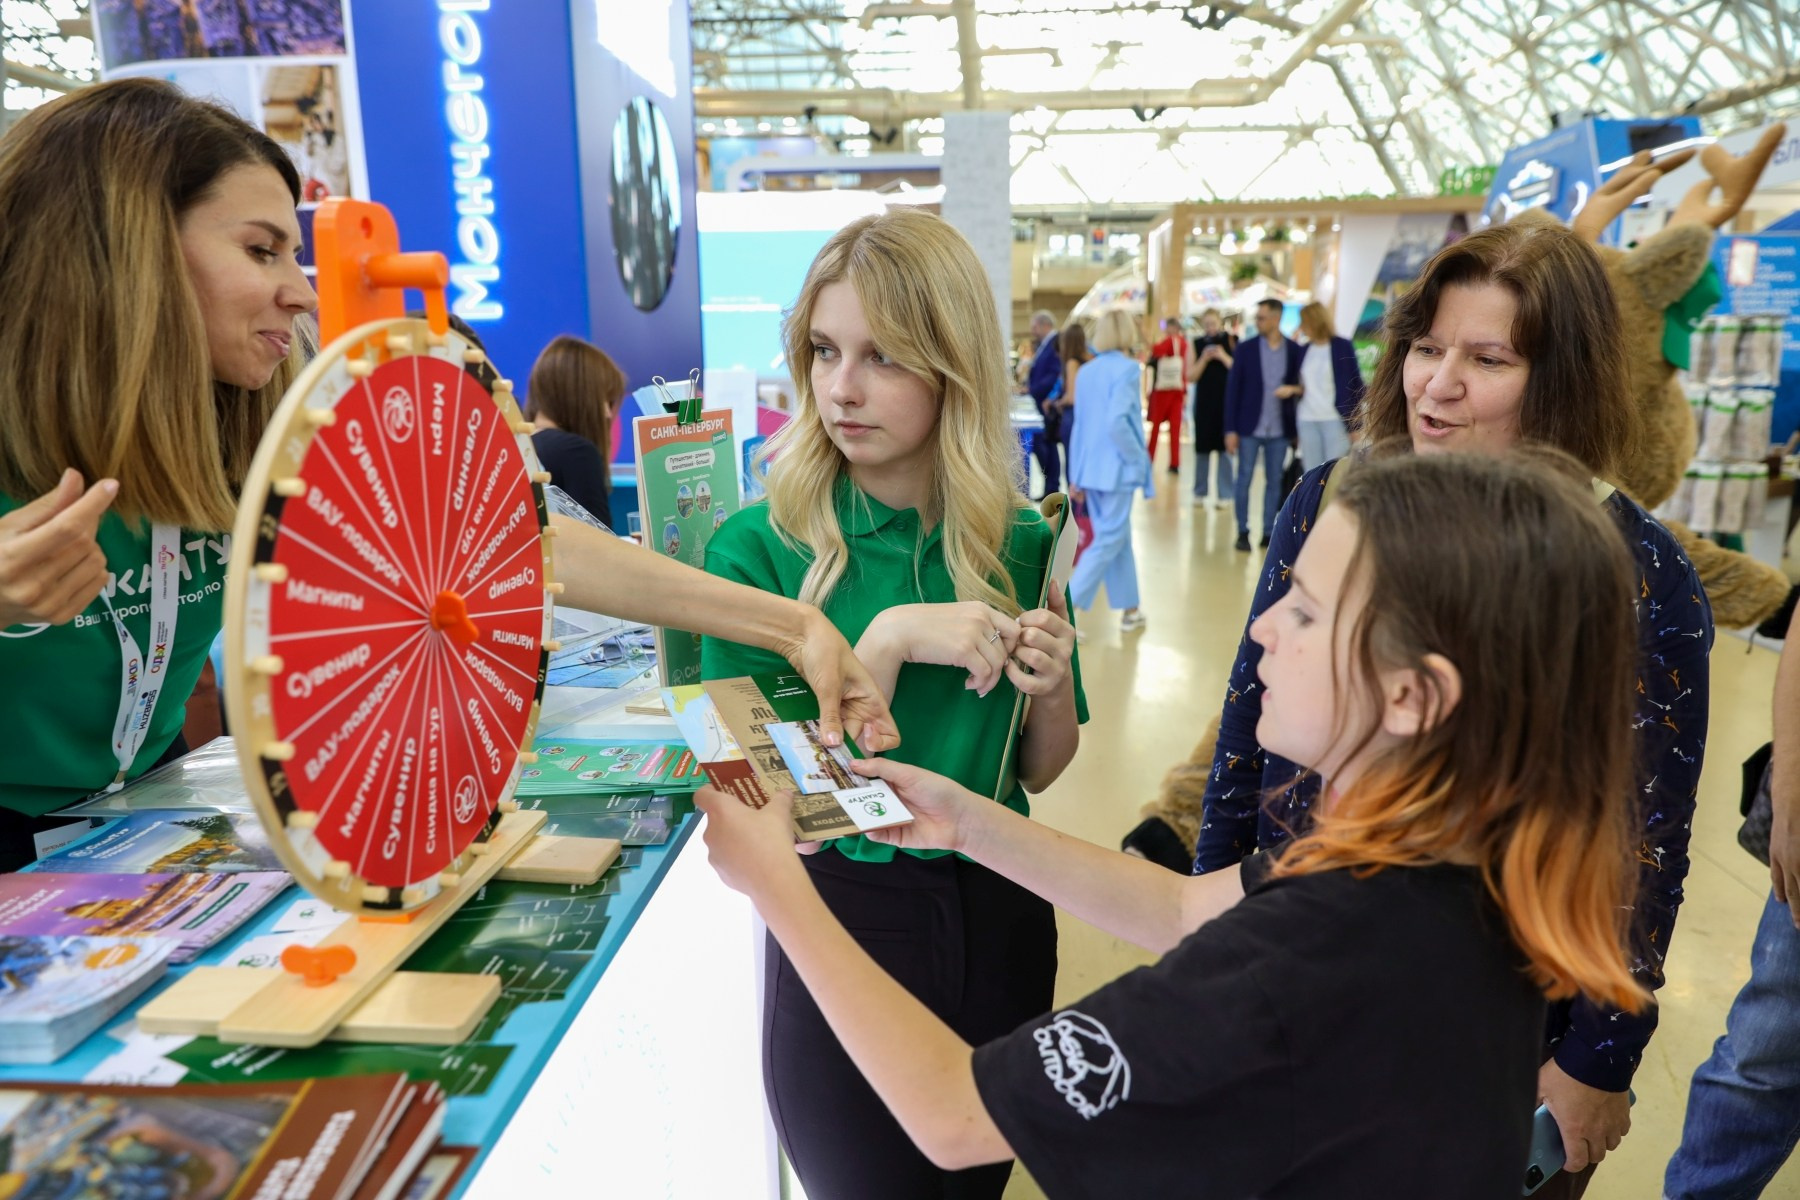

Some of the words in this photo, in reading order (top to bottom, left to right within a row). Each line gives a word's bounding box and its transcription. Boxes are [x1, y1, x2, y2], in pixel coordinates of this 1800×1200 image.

[438, 0, 503, 320] Мончего
[430, 382, 446, 455] Мерч
[650, 418, 725, 440] САНКТ-ПЕТЕРБУРГ
[345, 419, 399, 529] Сувенир
[453, 408, 482, 511] Сувенир
[482, 448, 508, 503] Скидка
[306, 486, 403, 587] ВАУ-подарок
[461, 527, 477, 555] тур
[466, 501, 527, 584] ВАУ-подарок
[473, 504, 486, 525] на
[74, 613, 101, 629] Ваш
[205, 581, 221, 596] по
[286, 579, 365, 612] Магниты
[489, 566, 535, 599] Сувенир
[286, 643, 371, 699] Сувенир
[492, 629, 534, 650] Магниты
[139, 689, 158, 730] KUZBASS
[464, 649, 524, 712] ВАУ-подарок
[304, 663, 401, 782] ВАУ-подарок
[429, 707, 441, 743] тур
[467, 698, 501, 774] Сувенир
[339, 729, 392, 838] Магниты
[428, 747, 439, 772] на
[382, 737, 416, 860] Сувенир
[426, 776, 438, 854] Скидка
[811, 817, 834, 826] ВХОД
[1033, 1028, 1099, 1120] OUTDOOR
[1046, 1019, 1089, 1084] ASIA
